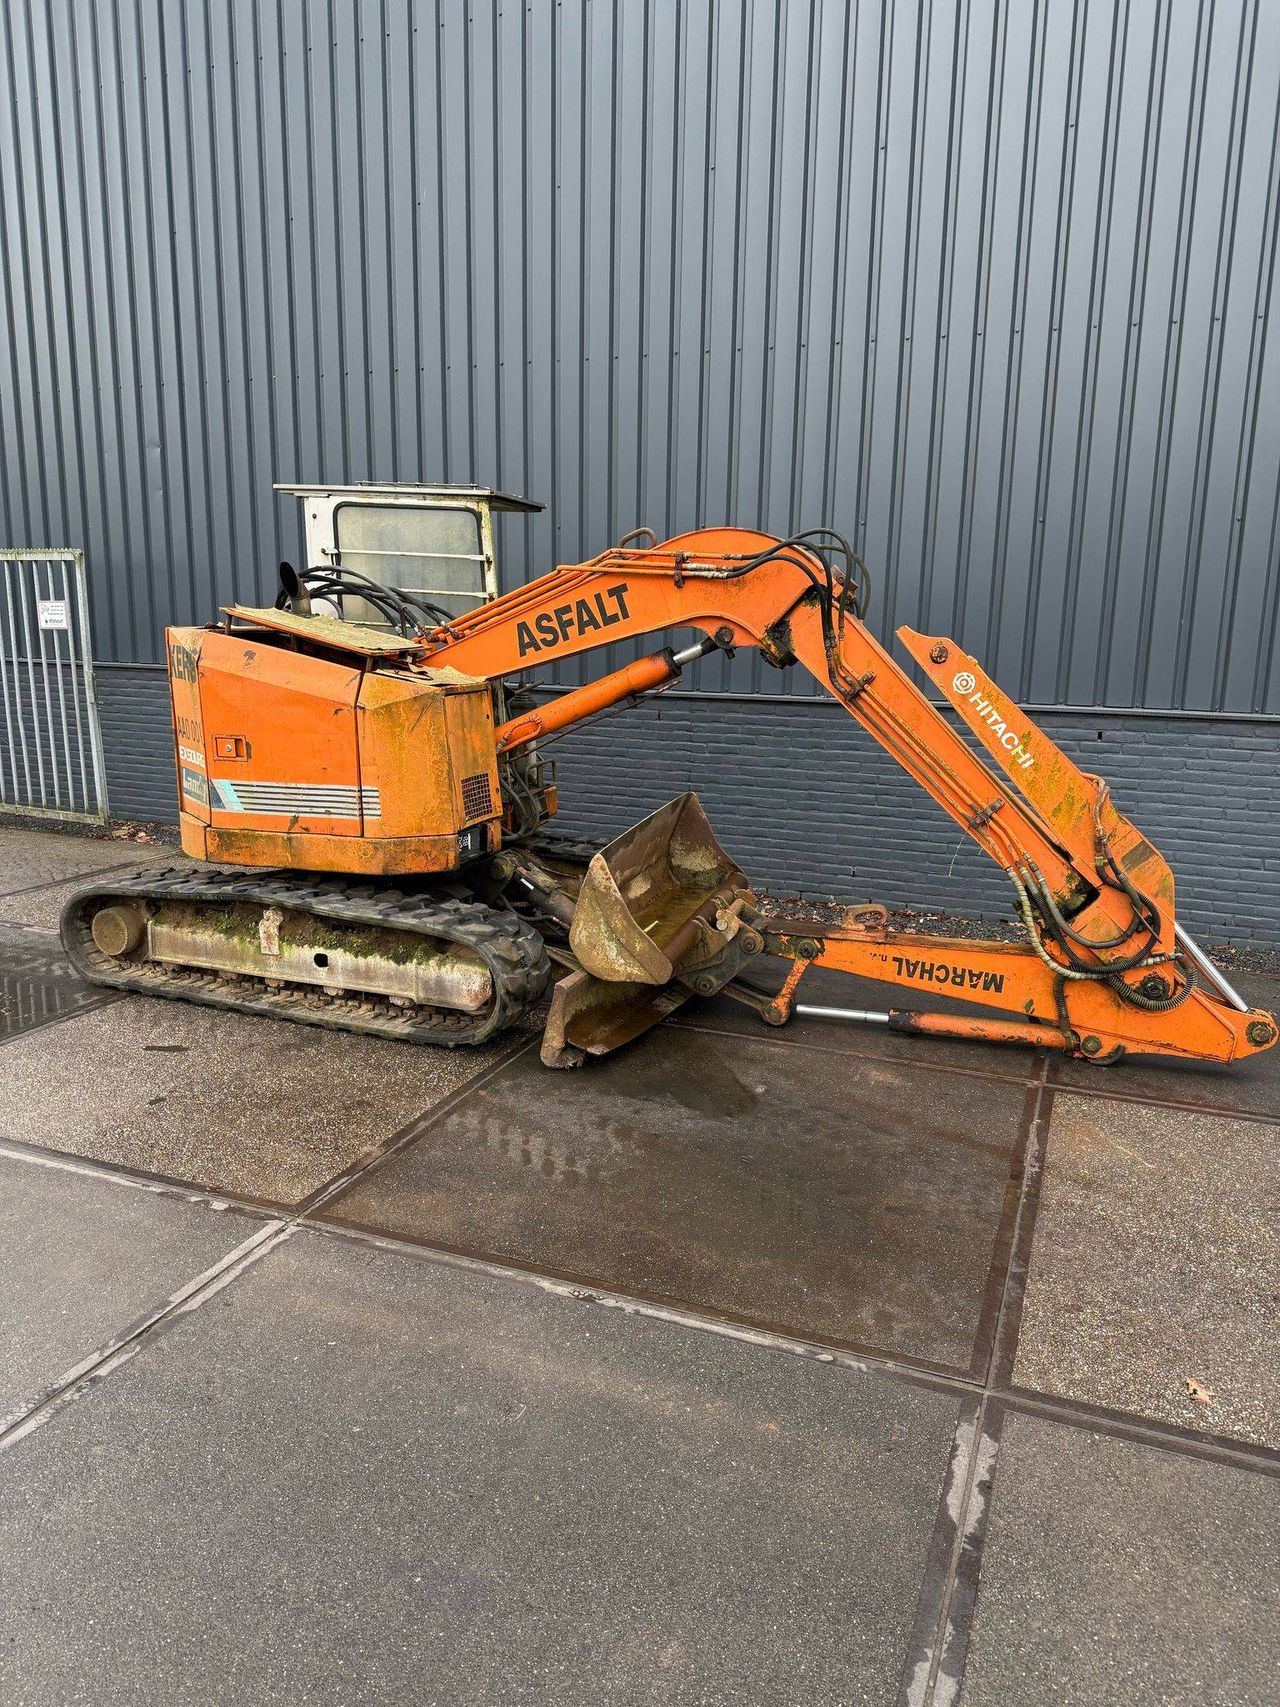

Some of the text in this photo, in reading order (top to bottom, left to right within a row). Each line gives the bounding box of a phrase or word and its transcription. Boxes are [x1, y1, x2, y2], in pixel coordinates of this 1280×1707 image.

[517, 583, 630, 657] ASFALT
[969, 691, 1035, 769] HITACHI
[892, 956, 1004, 993] MARCHAL
